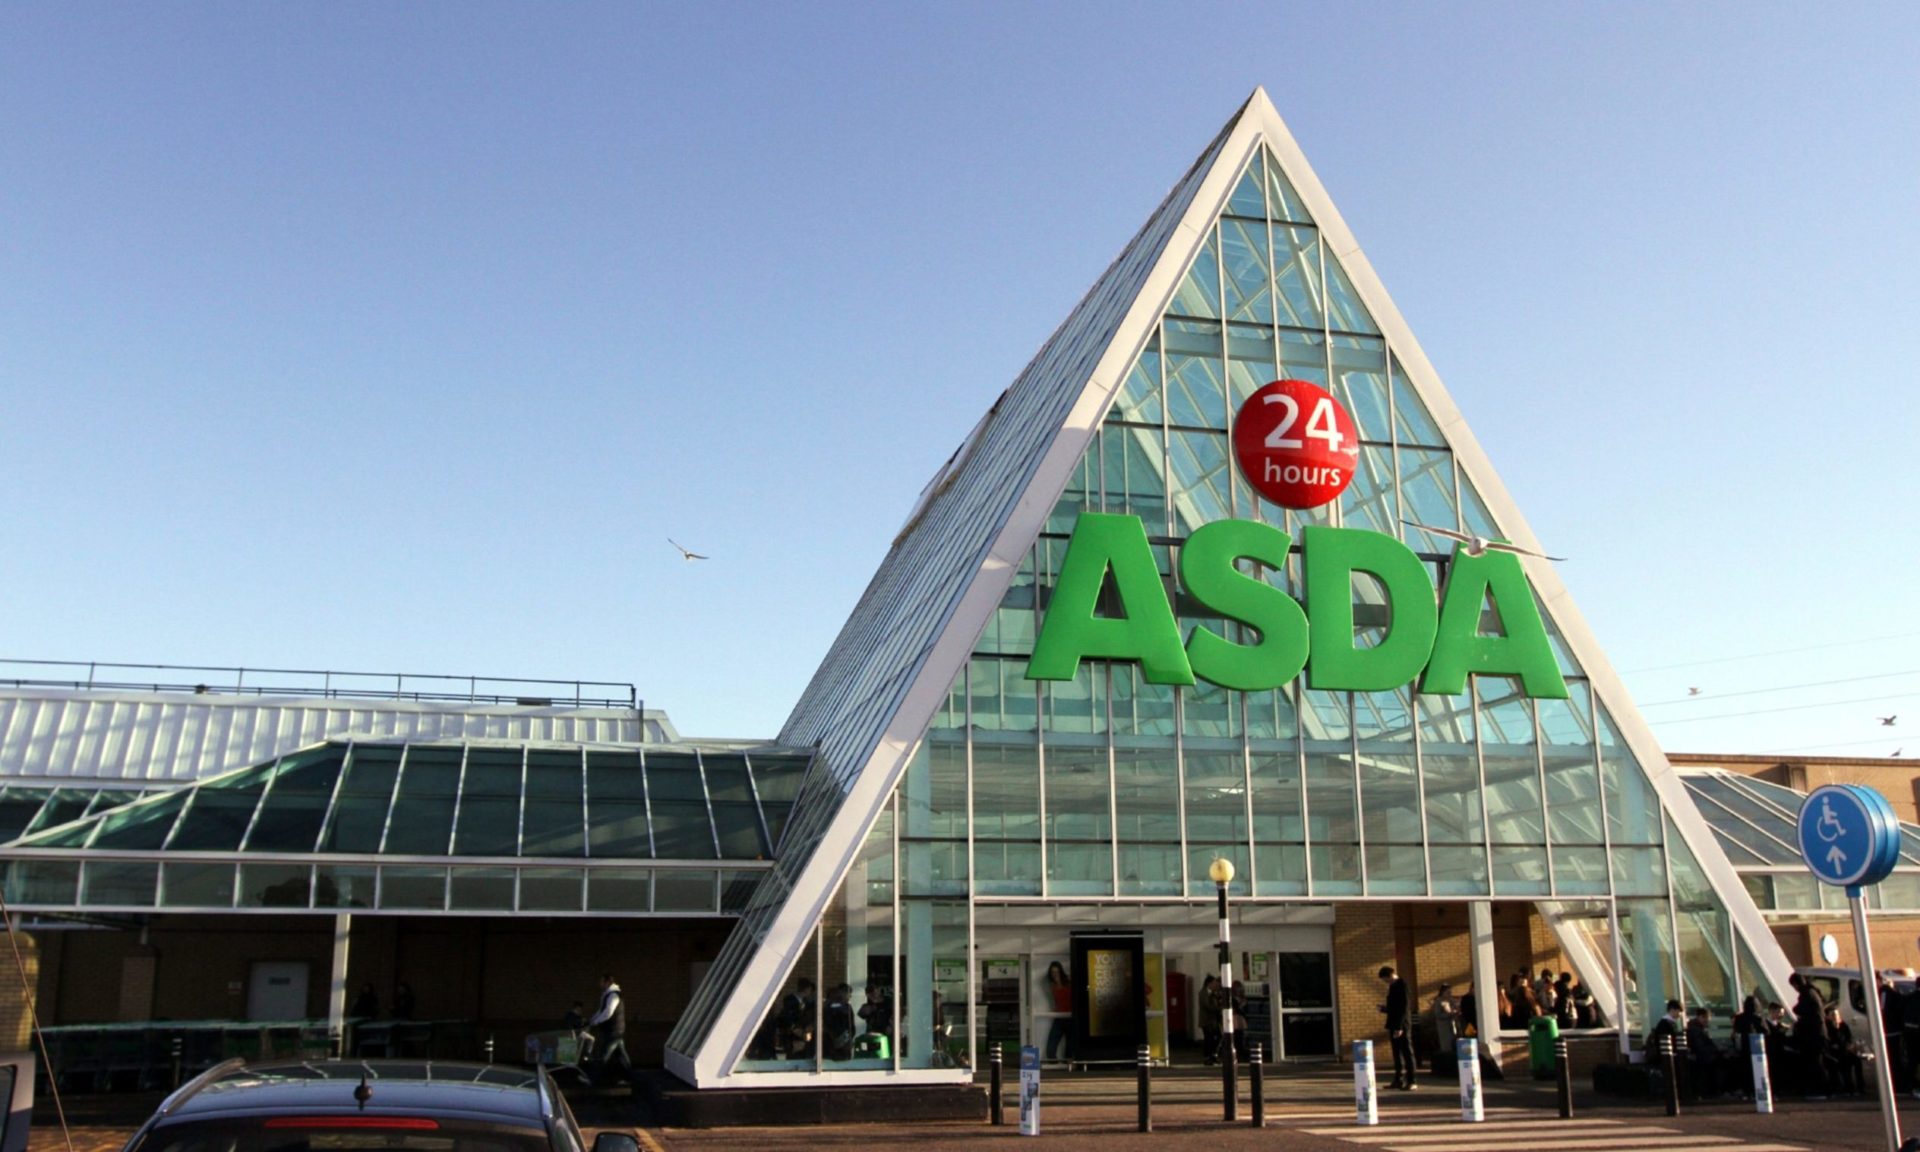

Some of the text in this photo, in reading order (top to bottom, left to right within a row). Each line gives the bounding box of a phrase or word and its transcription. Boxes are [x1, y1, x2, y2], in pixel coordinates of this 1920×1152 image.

[1263, 393, 1343, 452] 24
[1264, 457, 1341, 487] hours
[1025, 513, 1570, 699] ASDA
